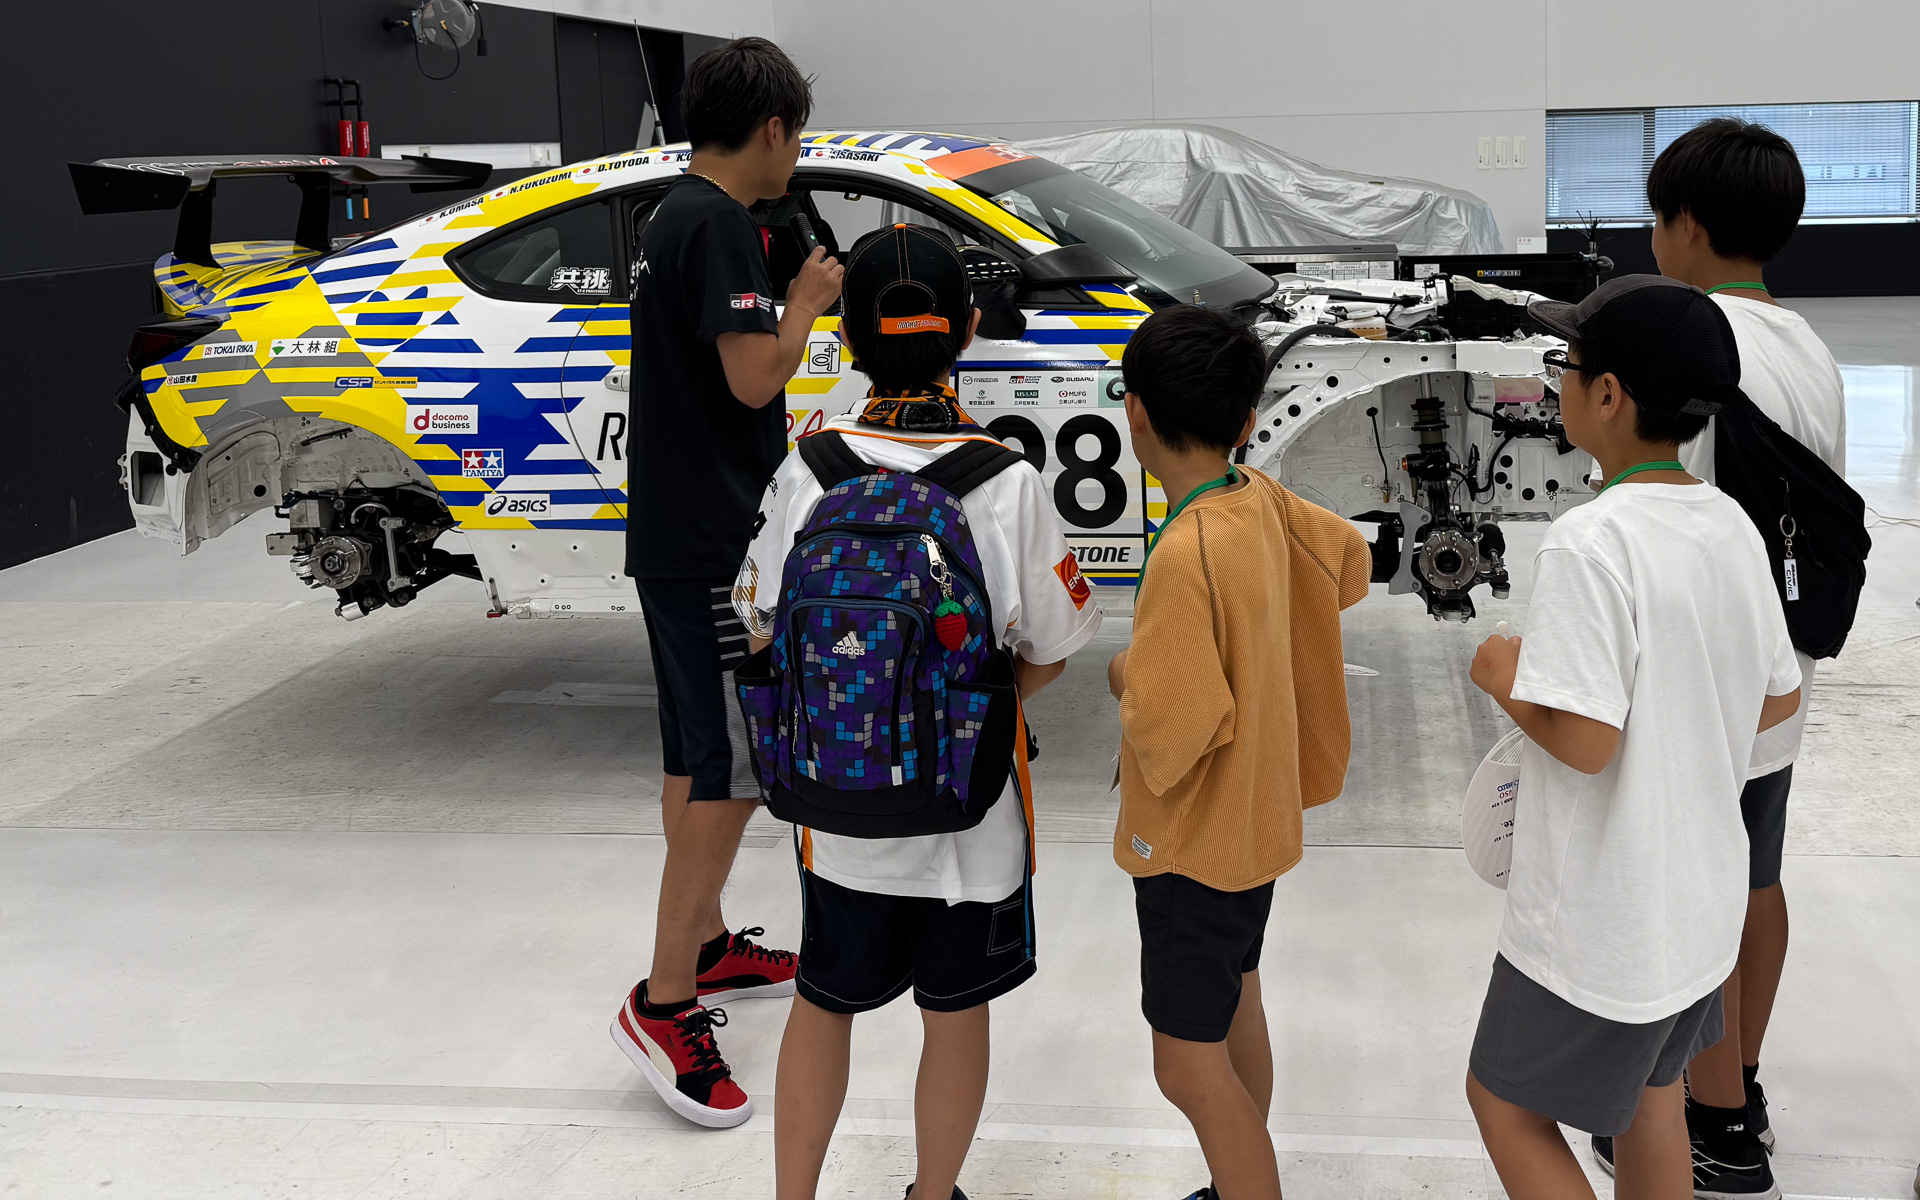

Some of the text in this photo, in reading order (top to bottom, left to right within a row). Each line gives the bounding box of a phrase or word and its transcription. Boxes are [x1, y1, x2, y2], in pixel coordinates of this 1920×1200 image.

[597, 156, 650, 172] D.TOYODA
[509, 171, 572, 195] N.FUKUZUMI
[213, 344, 254, 355] TOKAI RIKA
[290, 340, 338, 354] 大林組
[336, 378, 372, 387] CSP
[432, 412, 469, 421] docomo
[432, 420, 470, 429] business
[596, 412, 628, 461] R
[463, 469, 503, 477] TAMIYA
[507, 499, 548, 513] asics
[1069, 546, 1131, 563] TONE
[1786, 569, 1794, 597] CIVIC
[831, 646, 866, 656] adidas
